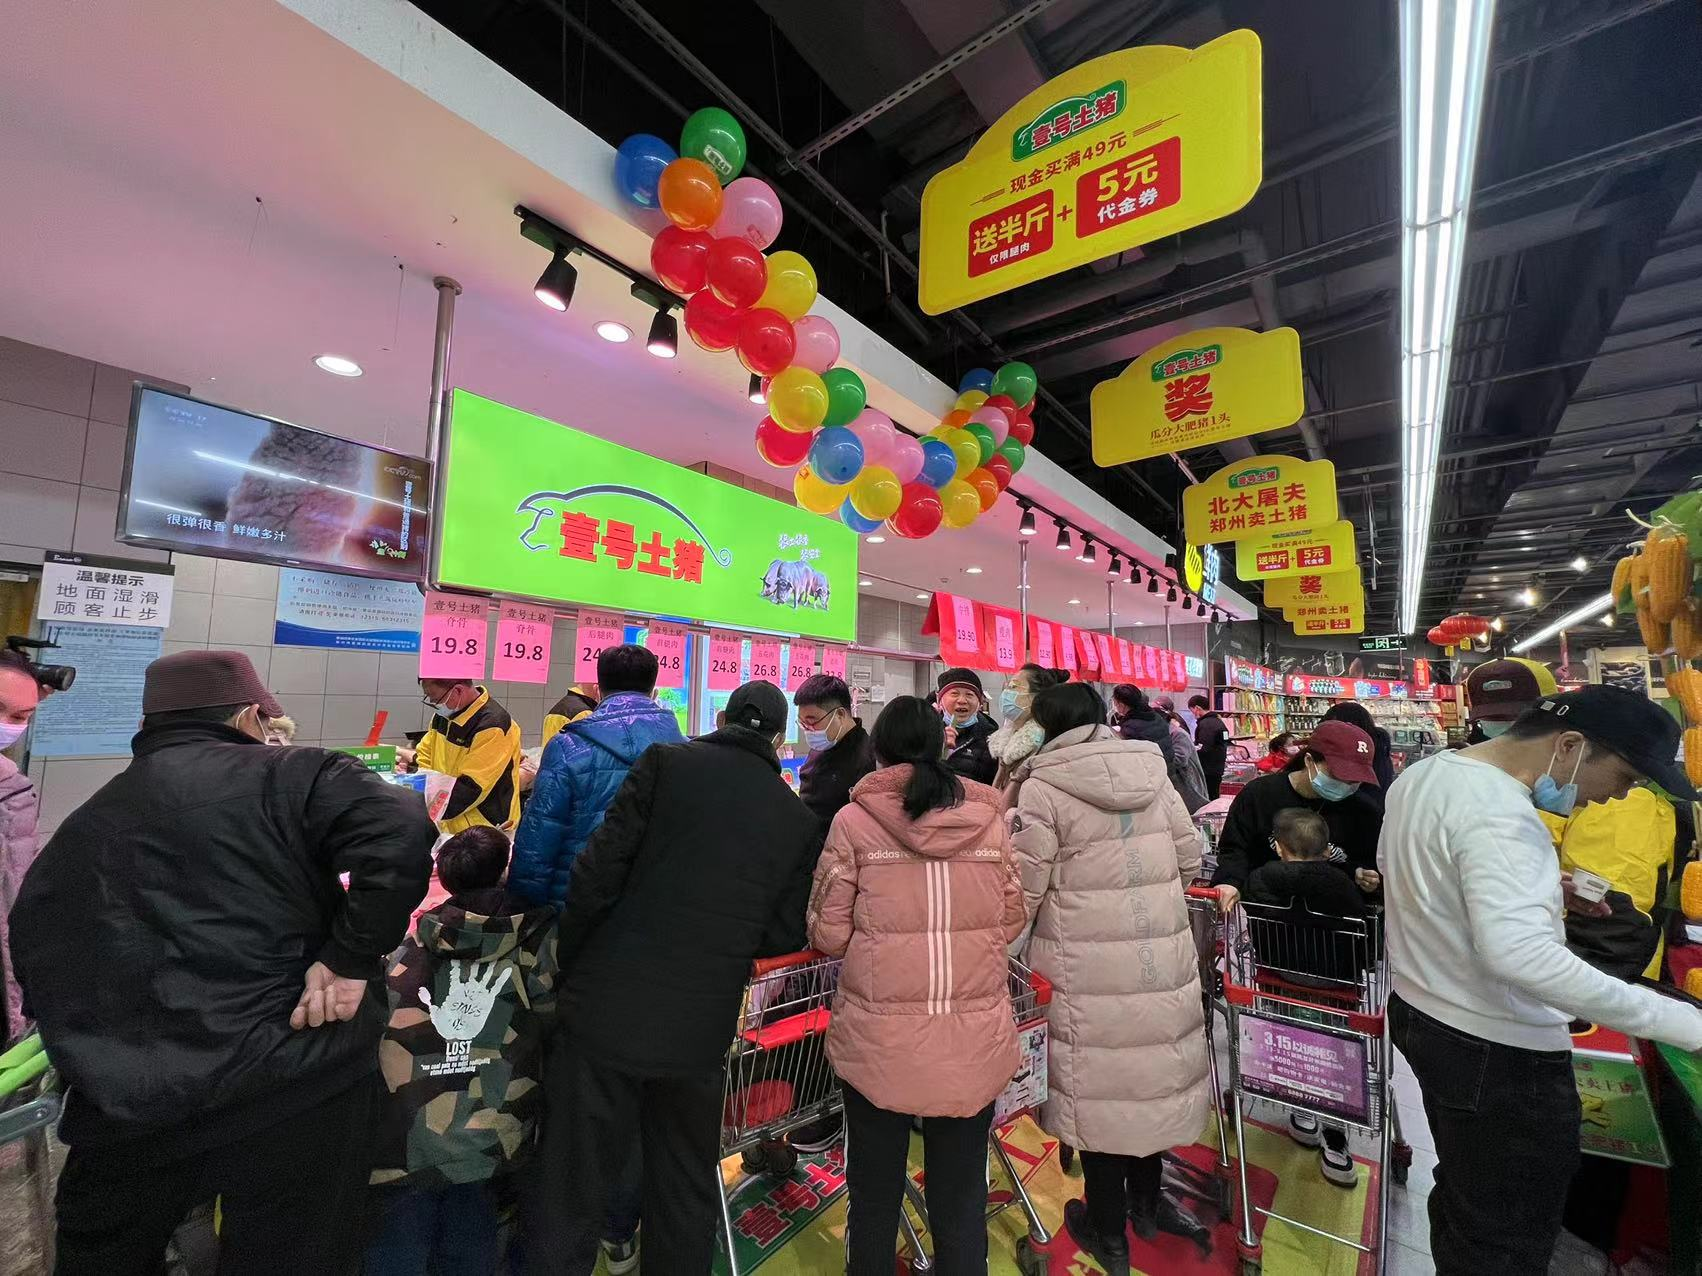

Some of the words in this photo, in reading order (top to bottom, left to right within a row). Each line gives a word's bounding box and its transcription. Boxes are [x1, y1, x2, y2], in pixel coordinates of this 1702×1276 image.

[1031, 89, 1118, 151] 壹号土猪
[1010, 131, 1127, 194] 现金买满49元
[973, 203, 1050, 256] 送半斤
[1097, 154, 1158, 202] 5元
[1097, 188, 1158, 223] 代金券
[989, 242, 1030, 266] 仅限腿肉
[1163, 350, 1217, 376] 壹号土猪
[1164, 373, 1213, 422] 奖
[1208, 482, 1307, 516] 北大屠夫
[166, 512, 227, 533] 很弹很香
[232, 523, 287, 542] 鲜嫩多汁
[1210, 504, 1308, 534] 郑州卖土猪
[559, 510, 705, 585] 壹号土猪
[1303, 549, 1325, 560] 5元
[77, 569, 147, 587] 温馨提示
[56, 584, 163, 606] 地面湿滑
[53, 601, 160, 621] 顾客止步
[433, 600, 481, 615] 壹号土猪
[507, 608, 548, 623] 壹号土猪
[431, 636, 478, 656] 19.8
[503, 641, 543, 662] 19.8
[583, 648, 602, 663] 24
[658, 656, 681, 670] 4.8
[712, 659, 737, 674] 24.8
[754, 664, 777, 677] 26.8
[792, 666, 811, 679] 26.8
[1357, 741, 1368, 753] R
[868, 849, 900, 860] adidas
[446, 1040, 472, 1056] LOST
